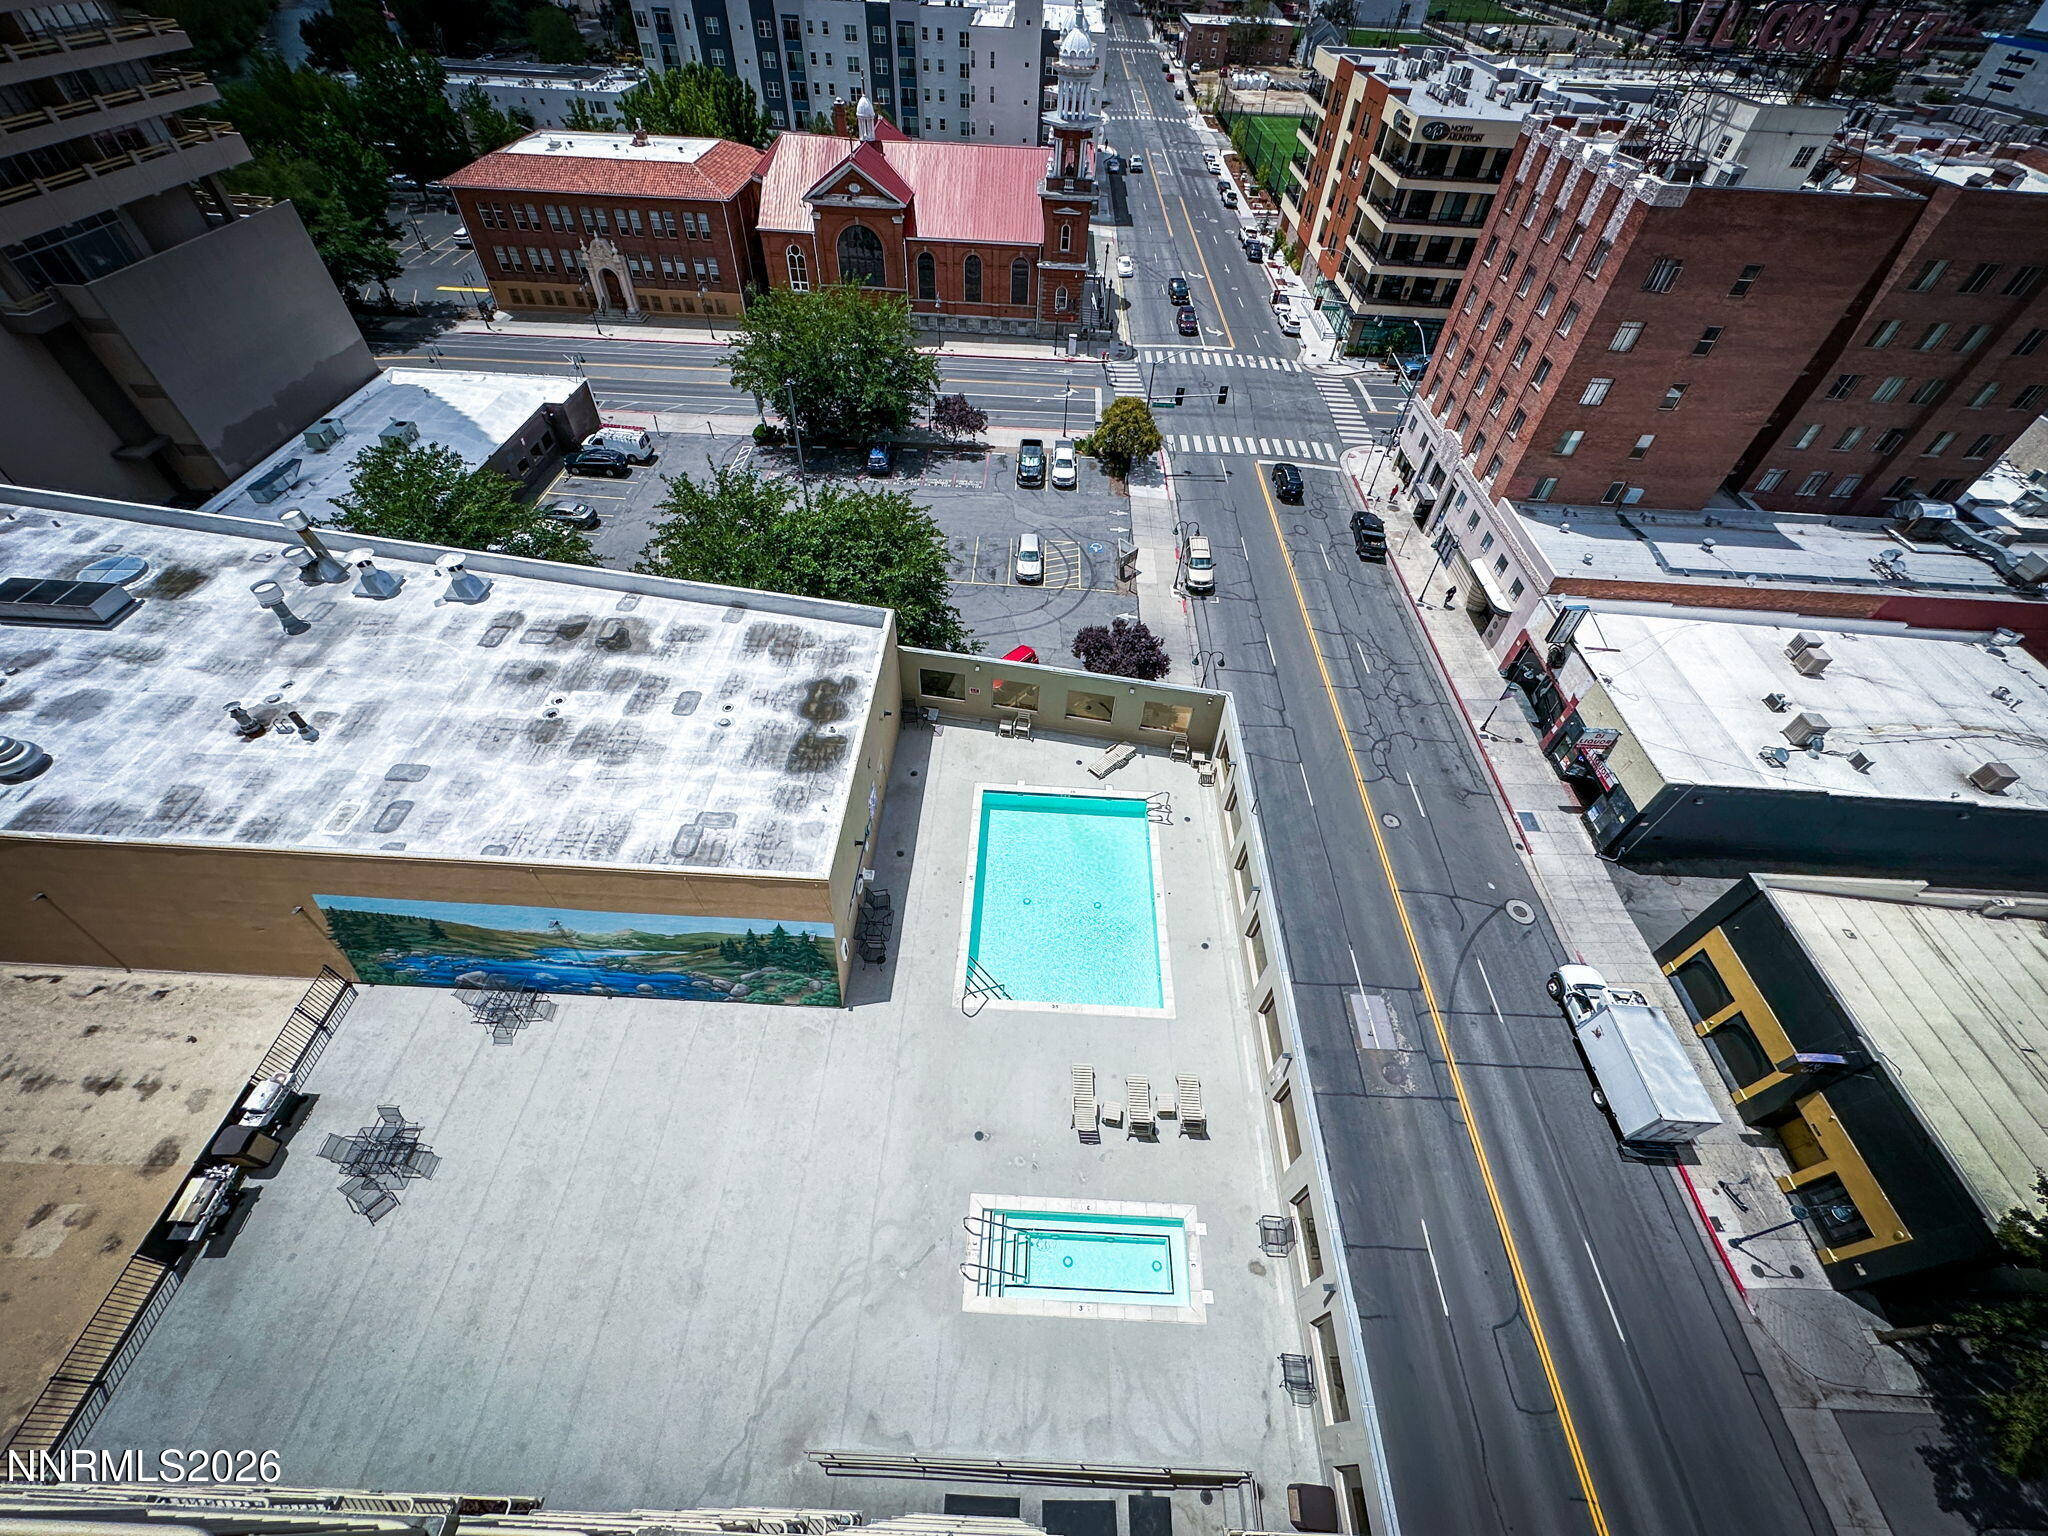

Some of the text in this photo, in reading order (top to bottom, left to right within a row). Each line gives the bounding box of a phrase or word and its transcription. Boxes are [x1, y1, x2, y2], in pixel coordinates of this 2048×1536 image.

[1684, 0, 1950, 59] EL CORTEZ
[1450, 124, 1473, 132] NORTH
